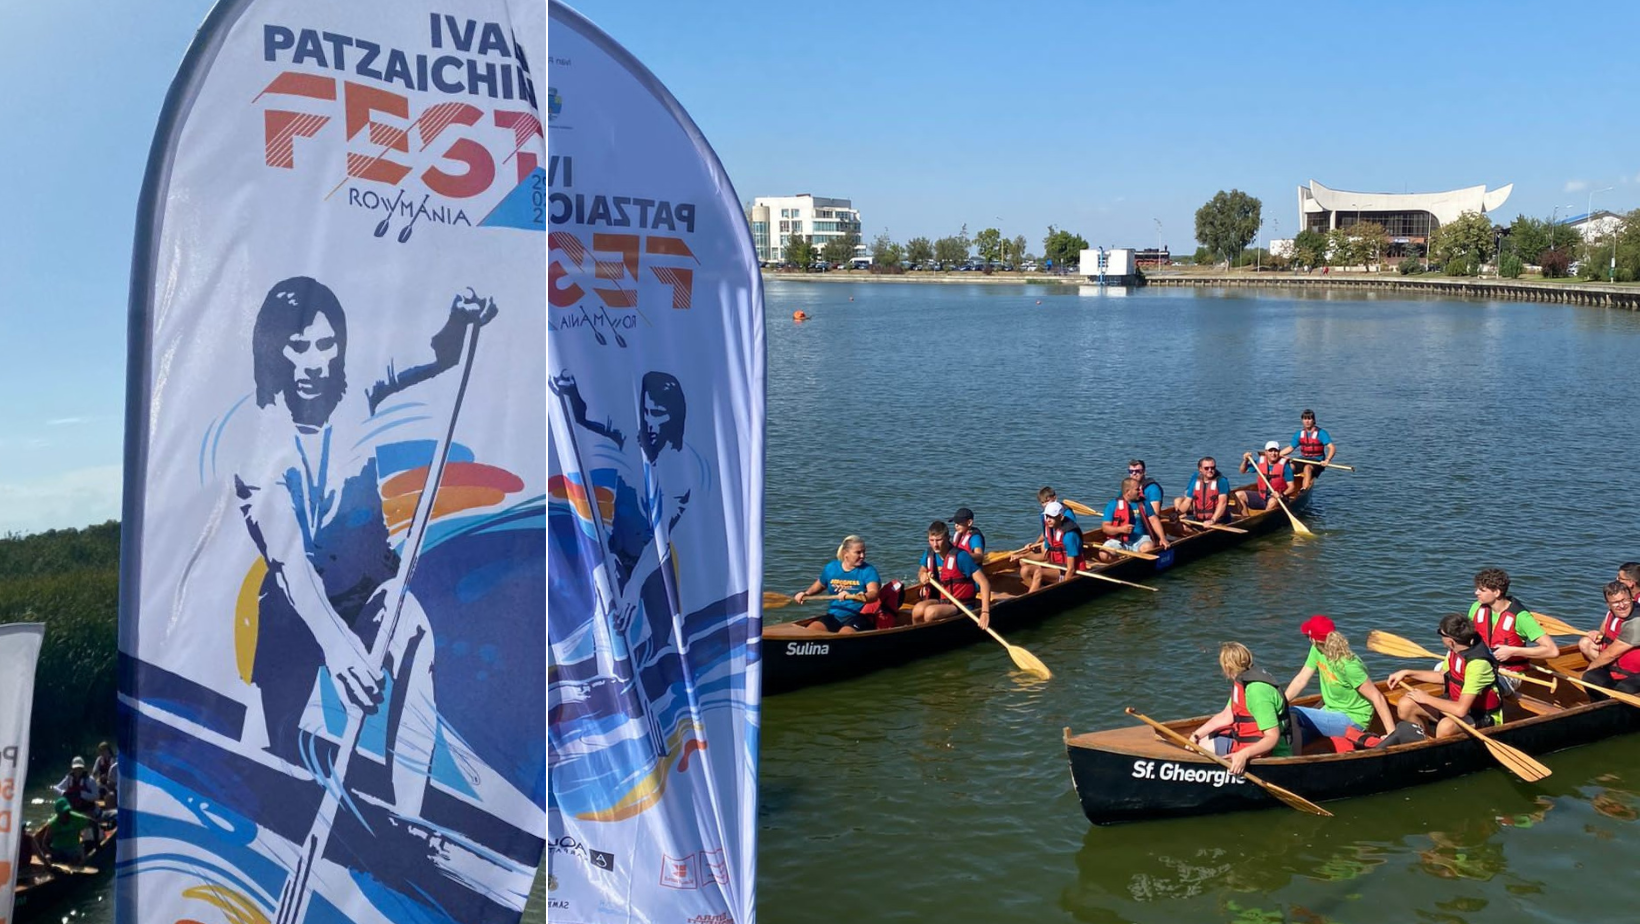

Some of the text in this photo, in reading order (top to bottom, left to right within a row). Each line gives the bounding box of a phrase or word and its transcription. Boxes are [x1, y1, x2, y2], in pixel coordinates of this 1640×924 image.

[264, 24, 538, 111] PATZAICHIN
[252, 71, 544, 198] FEST
[349, 188, 471, 229] ROWMANIA
[786, 641, 829, 655] Sulina
[1132, 760, 1155, 779] Sf.
